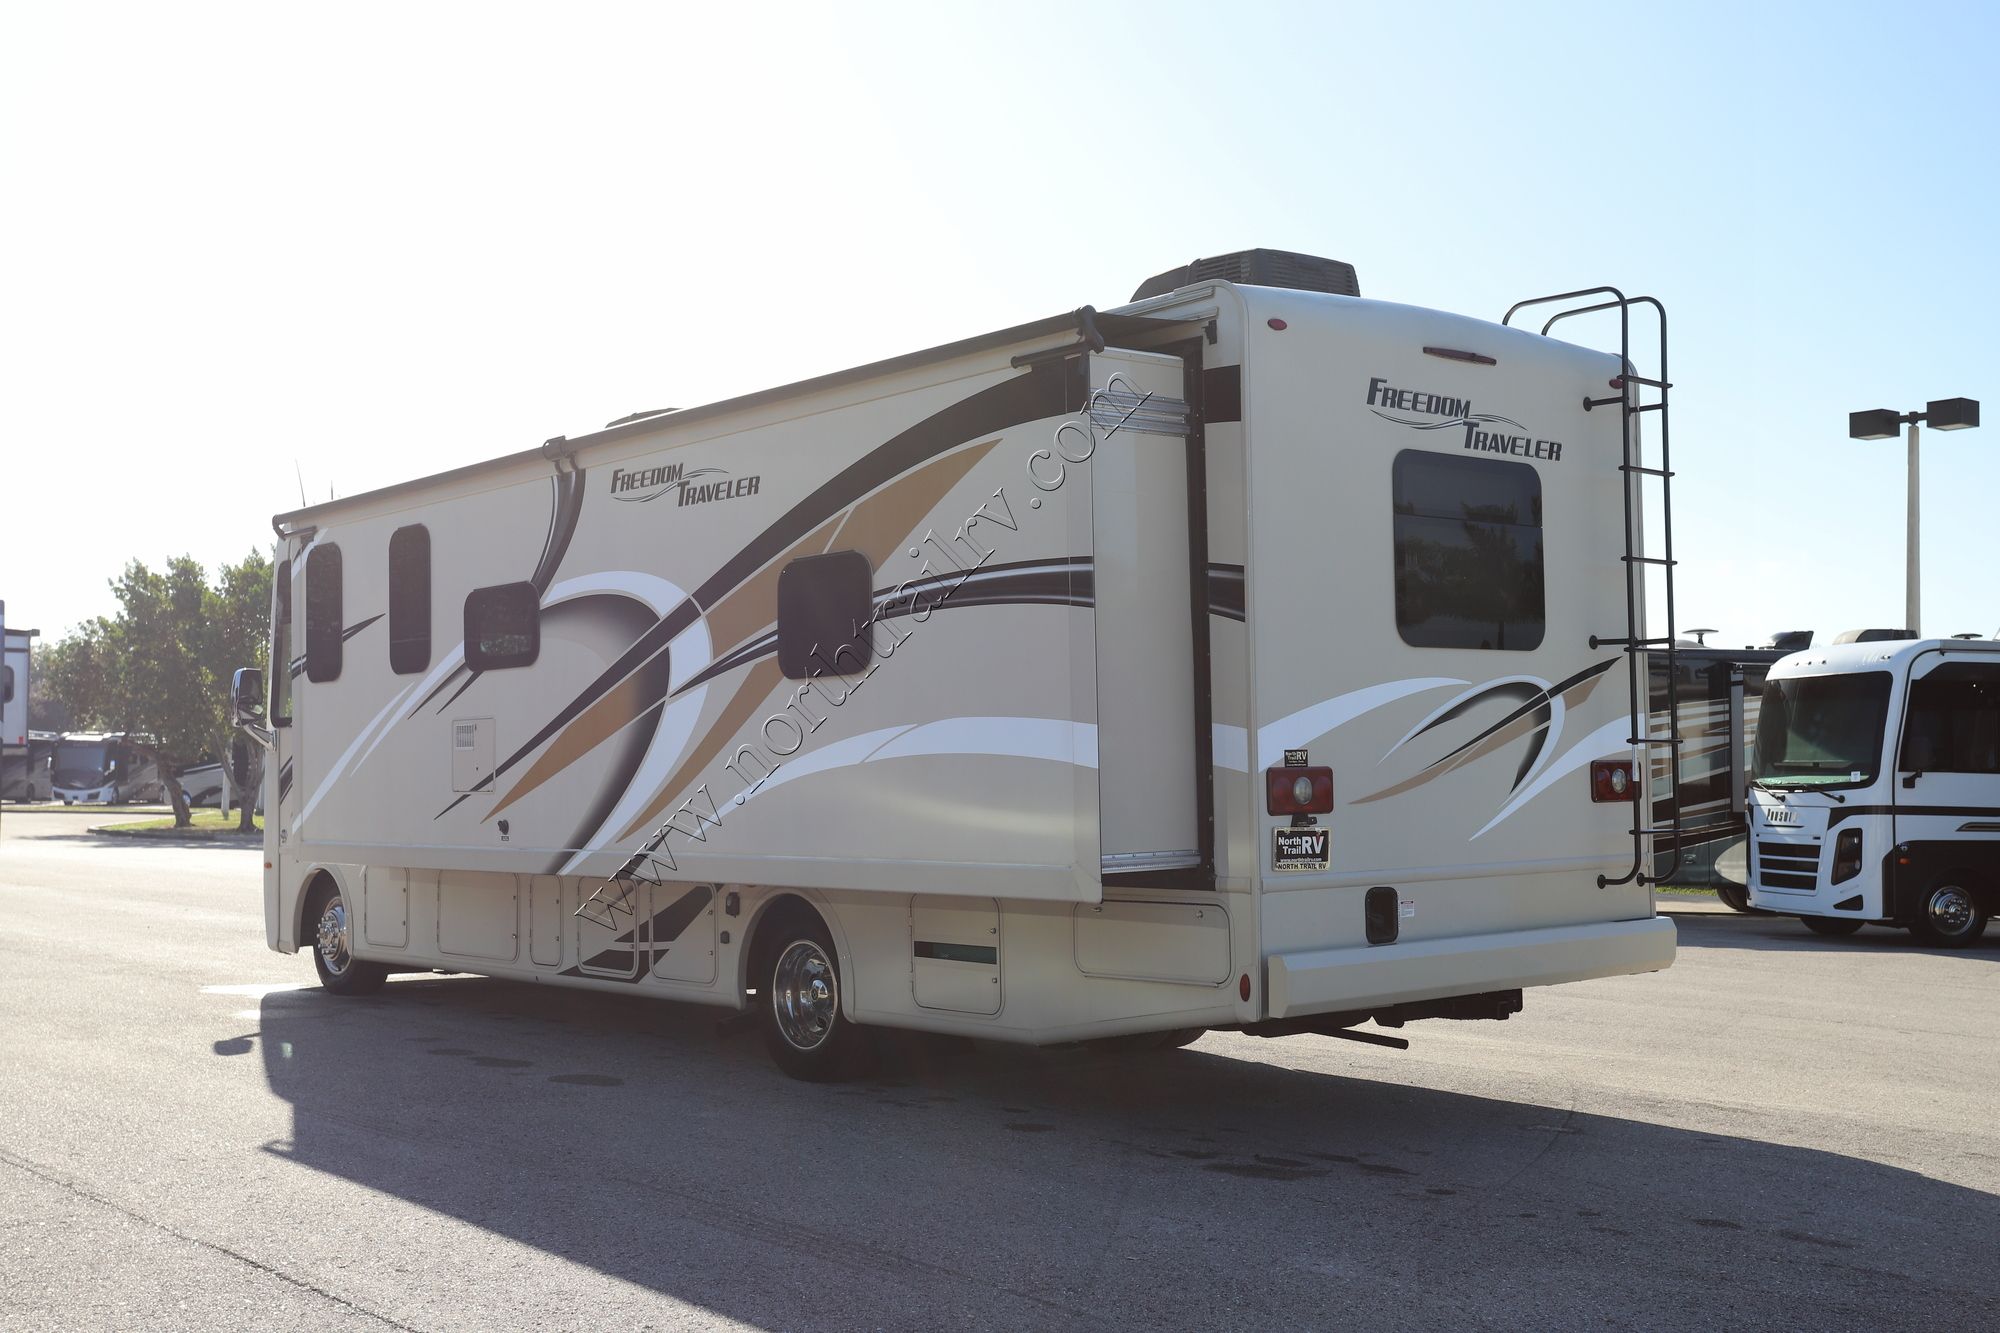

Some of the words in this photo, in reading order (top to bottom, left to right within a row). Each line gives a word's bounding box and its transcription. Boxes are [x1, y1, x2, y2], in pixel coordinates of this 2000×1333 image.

[1366, 377, 1472, 419] FREEDOM
[1462, 420, 1563, 462] TRAVELER
[610, 462, 684, 494] FREEDOM
[677, 475, 761, 507] TRAVELER
[1296, 751, 1307, 760] RV
[1766, 808, 1798, 823] PURSUI
[1278, 836, 1302, 845] North
[1282, 846, 1302, 855] Trail
[1301, 836, 1325, 855] RV
[1300, 862, 1317, 870] TRAIL
[1318, 862, 1327, 870] RV
